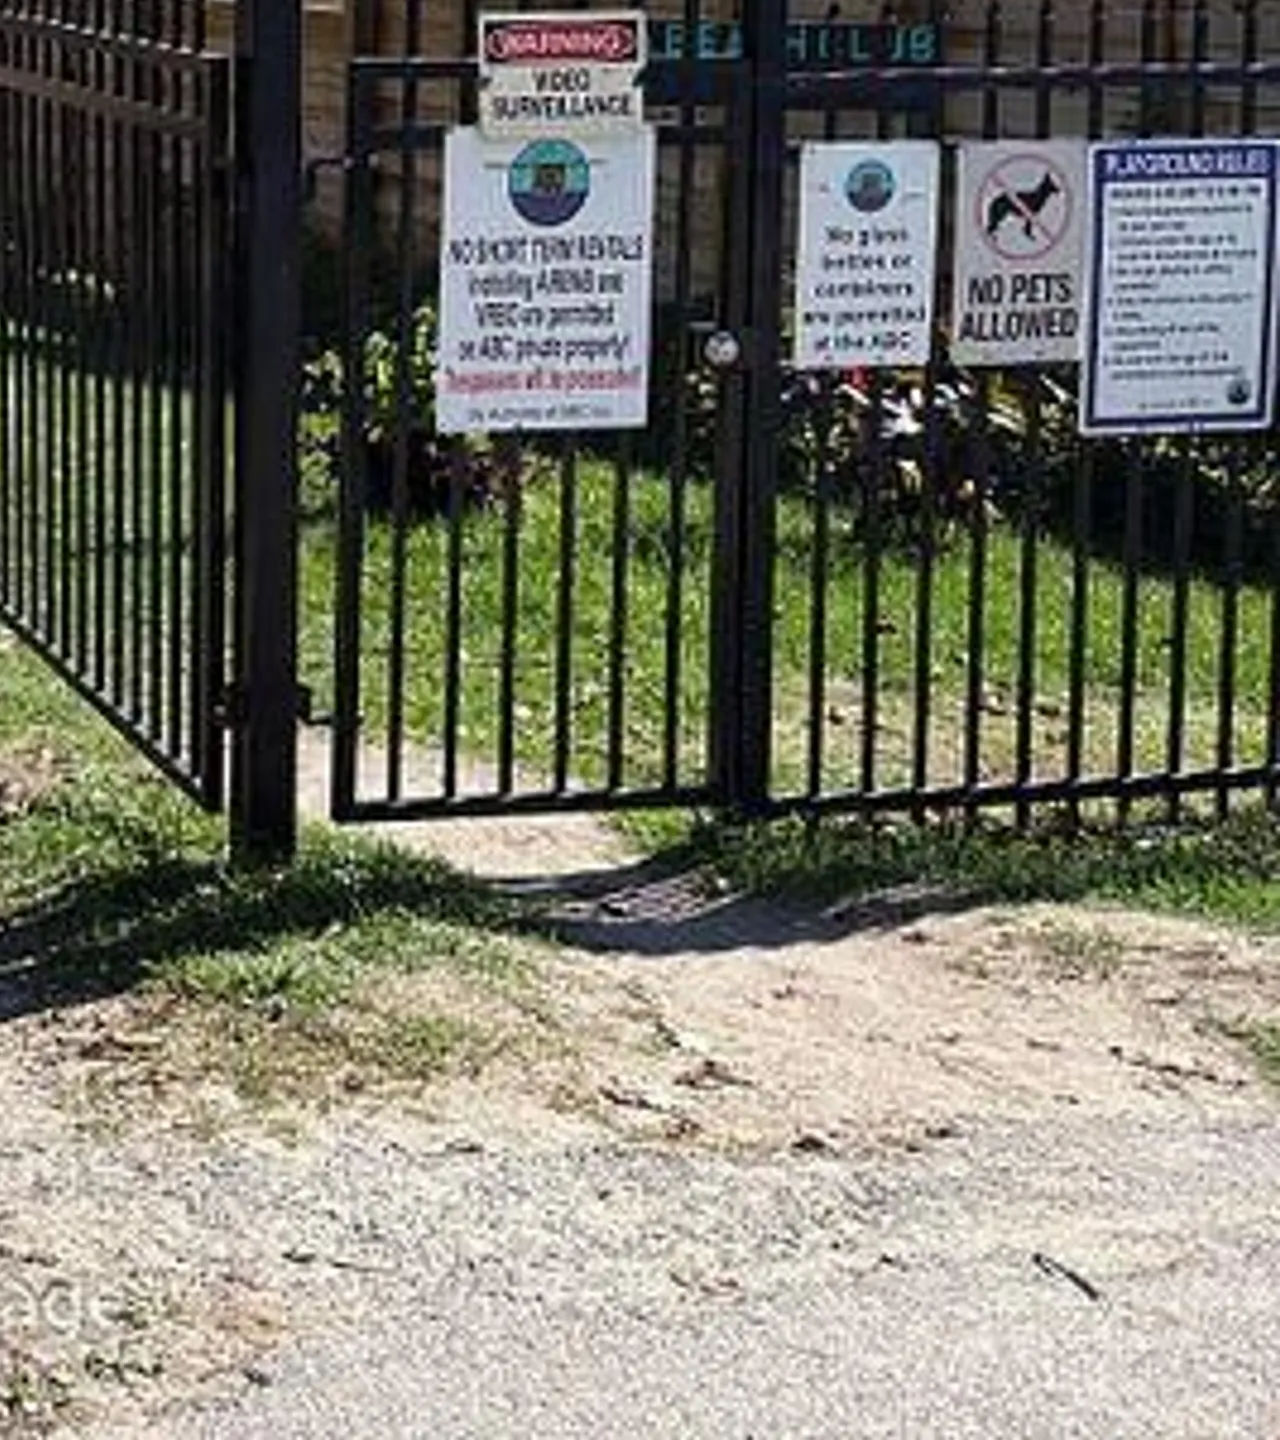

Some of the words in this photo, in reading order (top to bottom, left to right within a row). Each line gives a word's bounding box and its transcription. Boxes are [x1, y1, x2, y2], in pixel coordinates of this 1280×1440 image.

[501, 28, 622, 56] WARNING
[532, 68, 590, 91] VIDEO
[493, 94, 630, 120] SURVEILLANCE
[450, 239, 472, 264] NO
[968, 274, 1003, 304] NO
[1010, 273, 1074, 303] PETS
[959, 307, 1079, 341] ALLOWED
